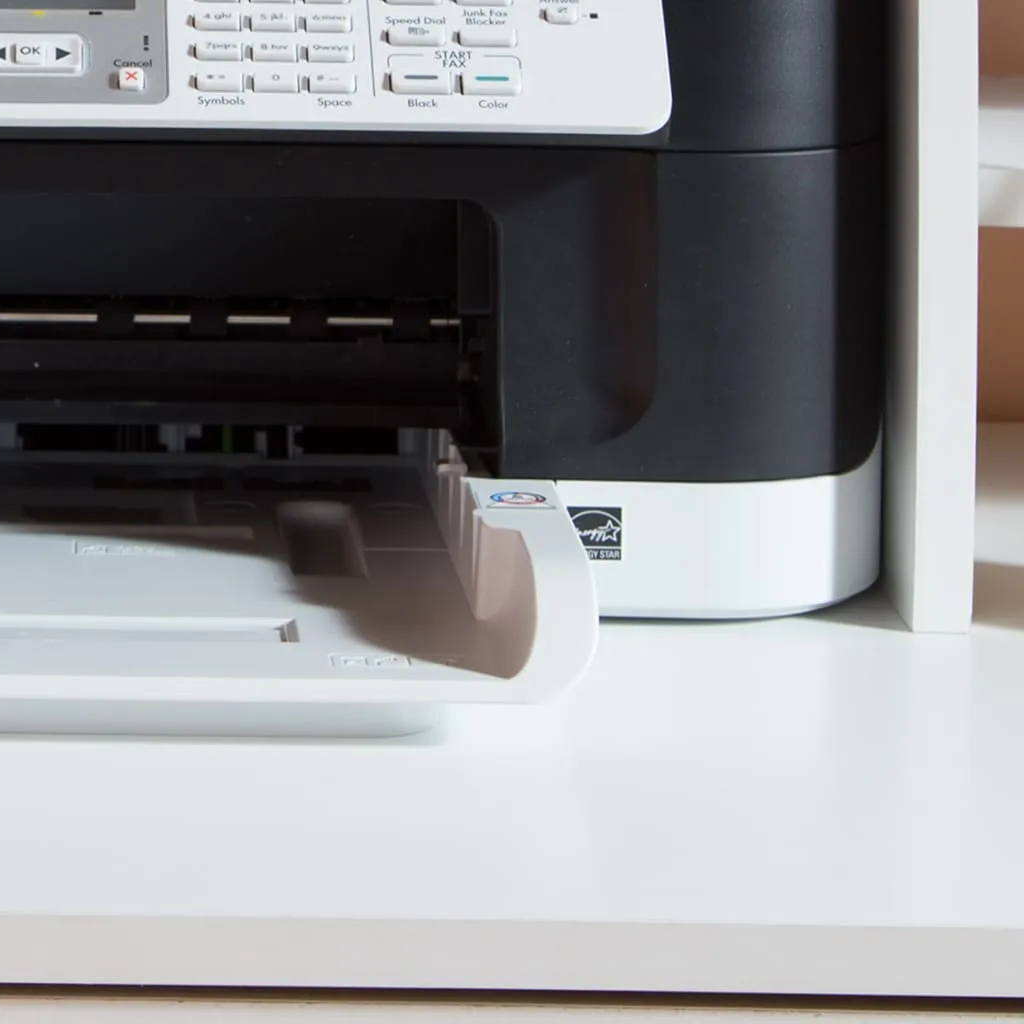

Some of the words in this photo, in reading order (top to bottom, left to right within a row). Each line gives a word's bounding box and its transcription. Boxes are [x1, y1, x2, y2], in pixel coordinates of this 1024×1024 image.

[462, 8, 485, 19] Junk
[489, 9, 509, 18] Fax
[385, 16, 421, 29] Speed
[424, 16, 446, 26] Dial
[465, 18, 506, 27] Blocker
[19, 45, 41, 57] OK
[434, 50, 472, 60] START
[113, 58, 153, 69] Cancel
[442, 59, 467, 69] FAX
[197, 95, 245, 107] Symbols
[317, 97, 352, 109] Space
[407, 99, 437, 108] Black
[478, 99, 508, 109] Color
[599, 549, 620, 559] STAR
